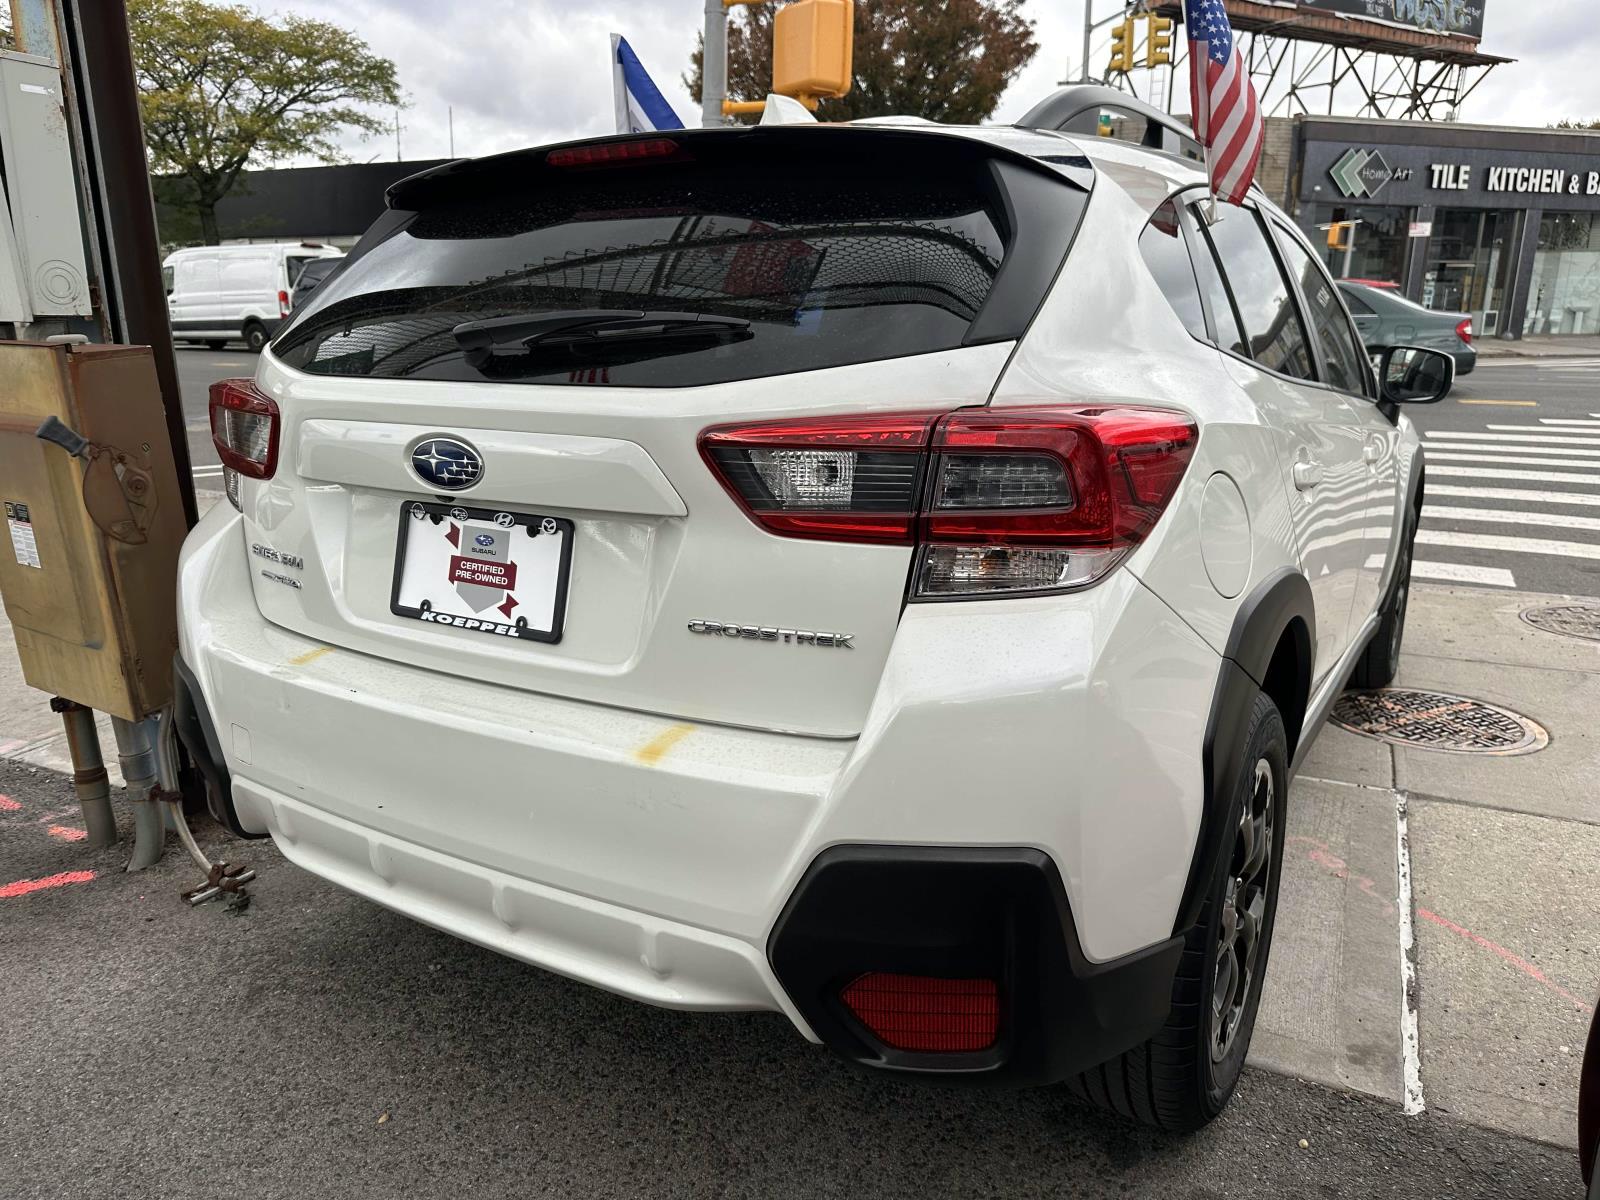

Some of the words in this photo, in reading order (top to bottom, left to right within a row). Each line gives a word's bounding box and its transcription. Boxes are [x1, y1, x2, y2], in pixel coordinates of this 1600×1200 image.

[1393, 167, 1414, 180] Art
[1431, 163, 1471, 190] TILE
[1488, 166, 1564, 194] KITCHEN
[1568, 174, 1580, 194] &
[471, 547, 497, 556] SUBARU
[460, 560, 505, 575] CERTIFIED
[455, 570, 508, 585] PRE-OWNED
[420, 611, 520, 638] KOEPPEL
[687, 618, 856, 650] CROSSTREK
